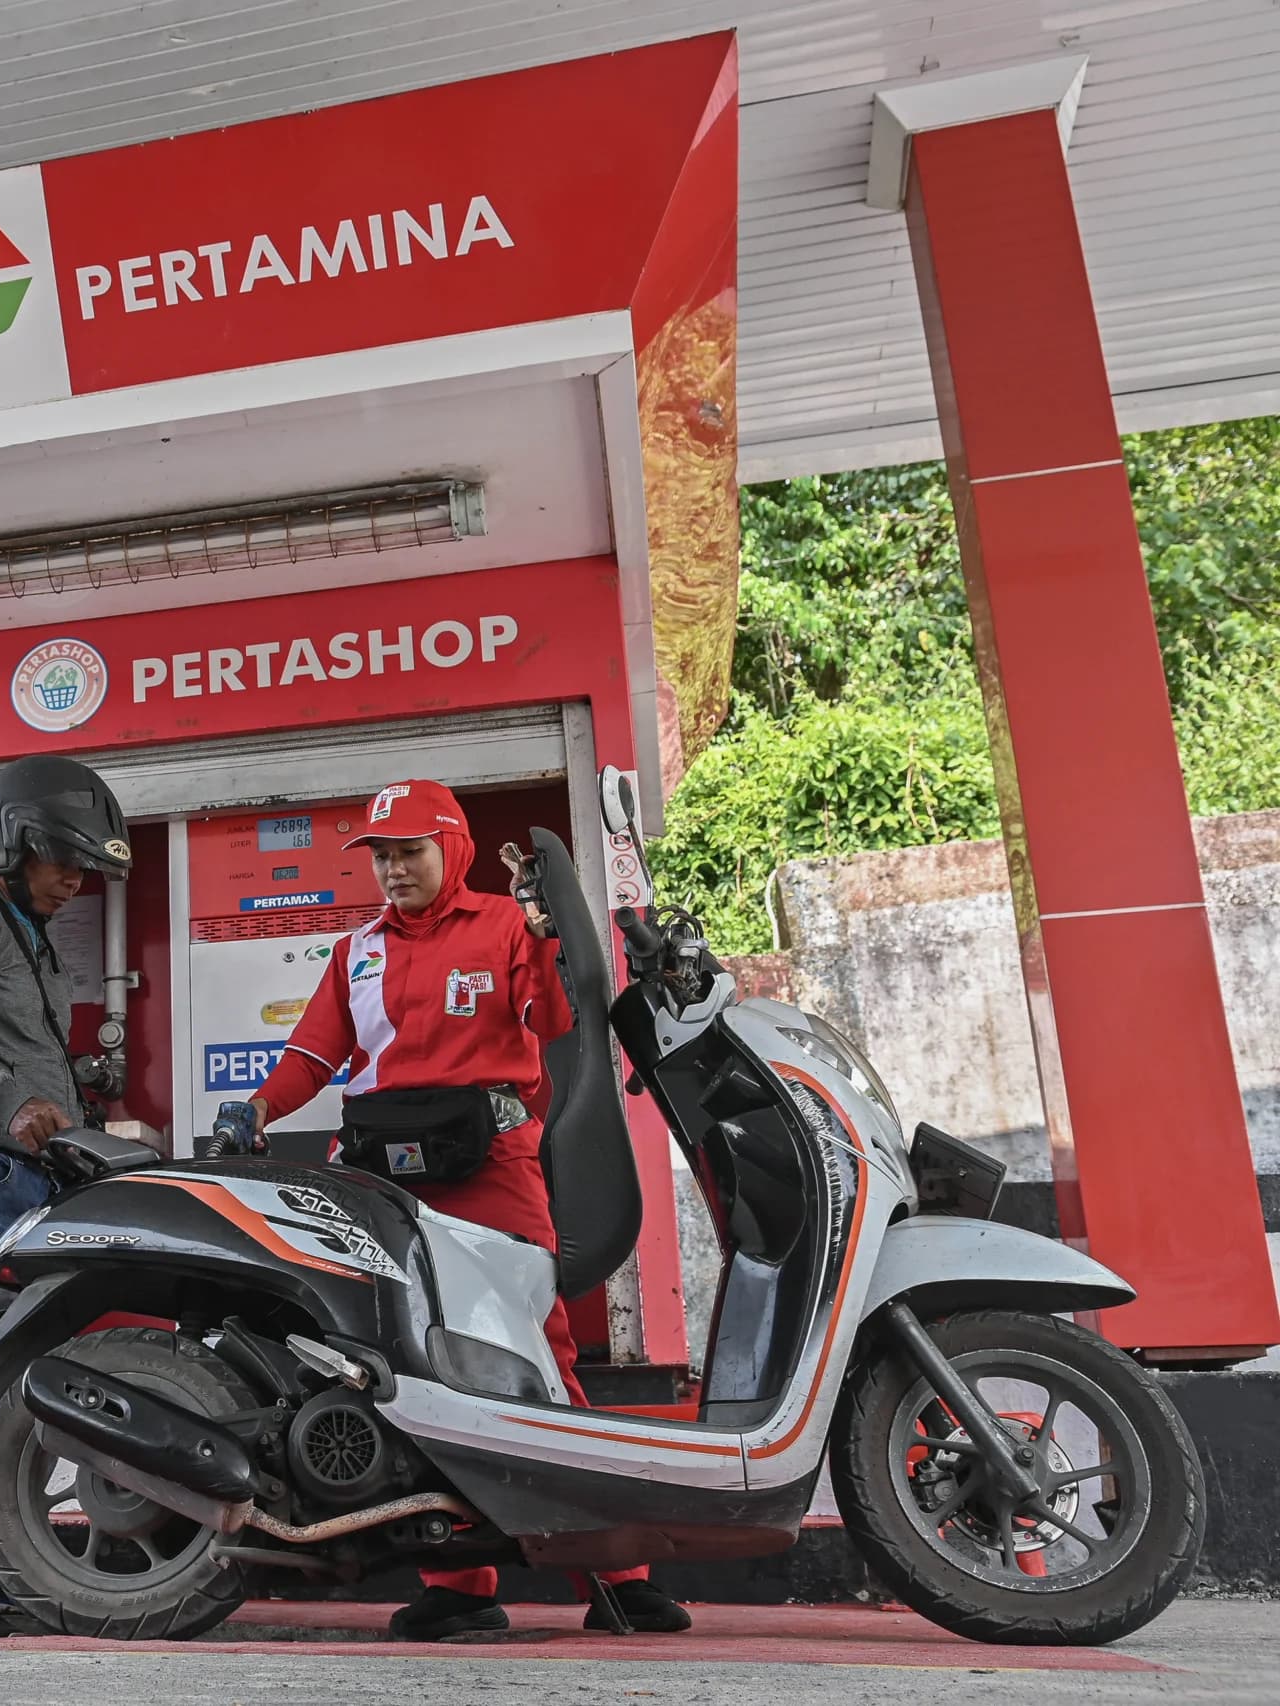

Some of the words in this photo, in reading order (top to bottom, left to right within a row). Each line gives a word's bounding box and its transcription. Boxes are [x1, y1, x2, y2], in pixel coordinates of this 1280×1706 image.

[75, 195, 515, 320] PERTAMINA
[18, 643, 99, 684] PERTASHOP
[132, 614, 518, 703] PERTASHOP
[273, 818, 311, 834] 26892
[230, 839, 251, 848] LITER
[253, 893, 320, 908] PERTAMAX
[469, 974, 489, 984] PASTI
